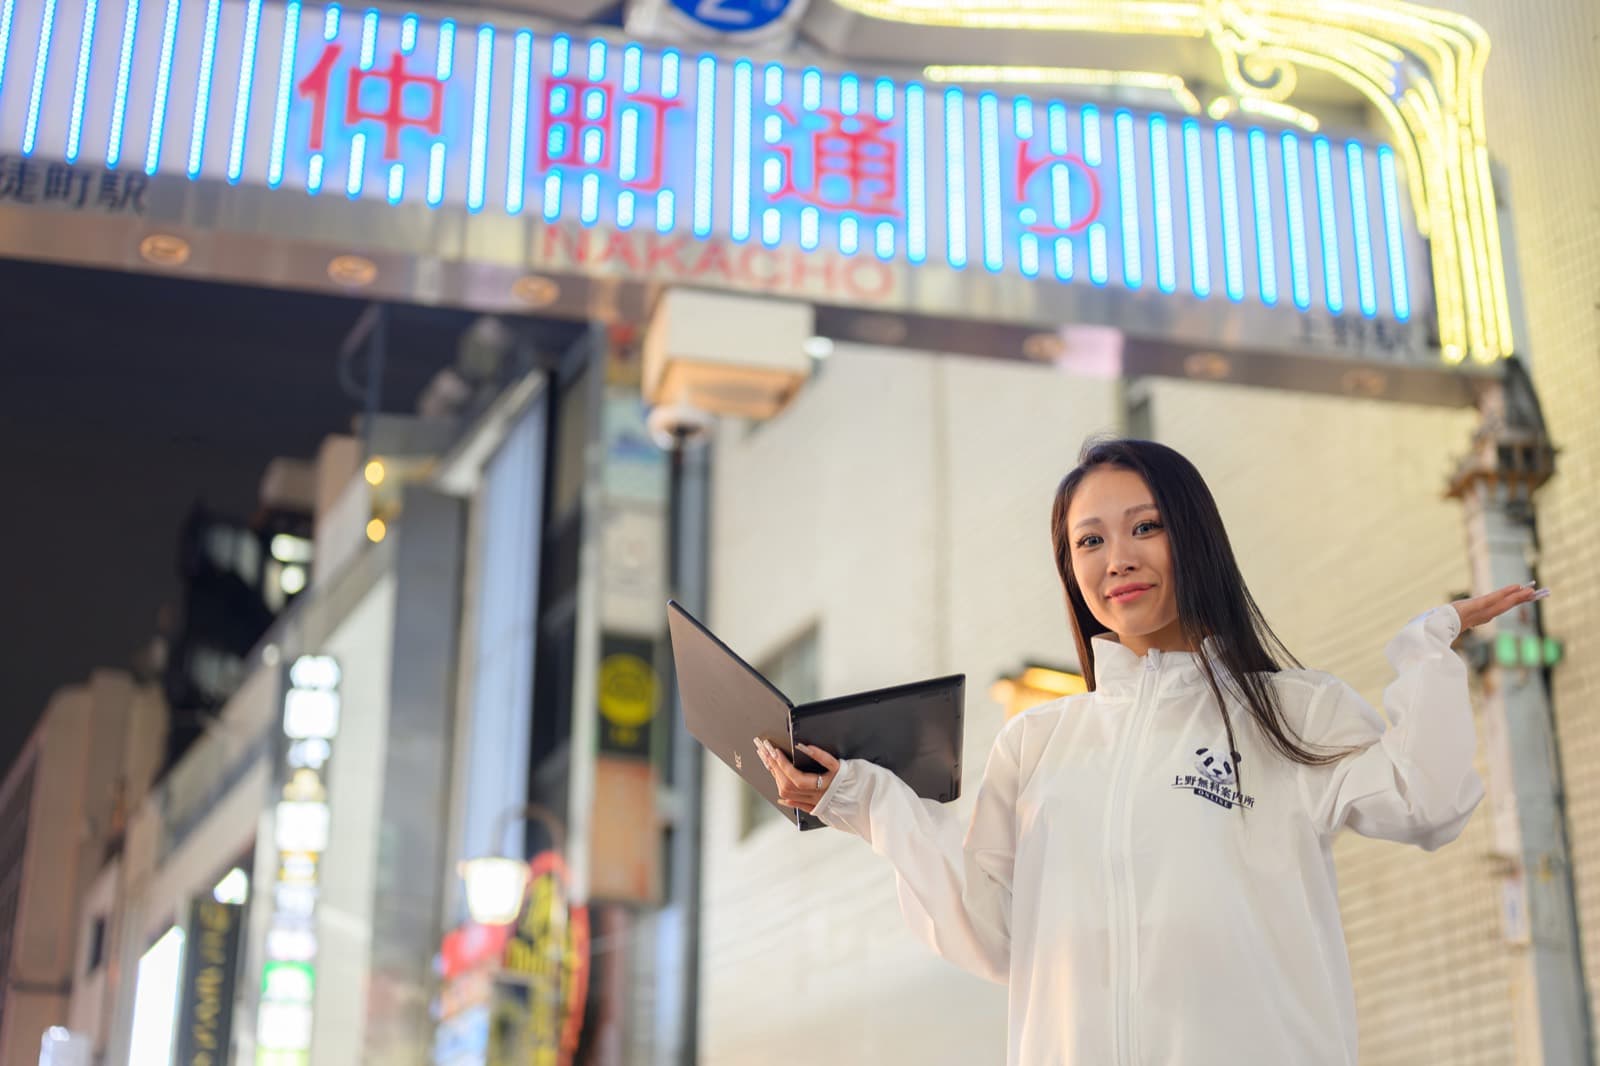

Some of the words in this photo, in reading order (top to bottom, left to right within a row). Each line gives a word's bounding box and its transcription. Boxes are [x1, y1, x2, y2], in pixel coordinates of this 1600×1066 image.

[299, 44, 1102, 235] 仲町通り
[543, 225, 895, 299] NAKACHO
[1171, 775, 1255, 808] 上野無料案内所
[1197, 788, 1230, 808] ONLINE
